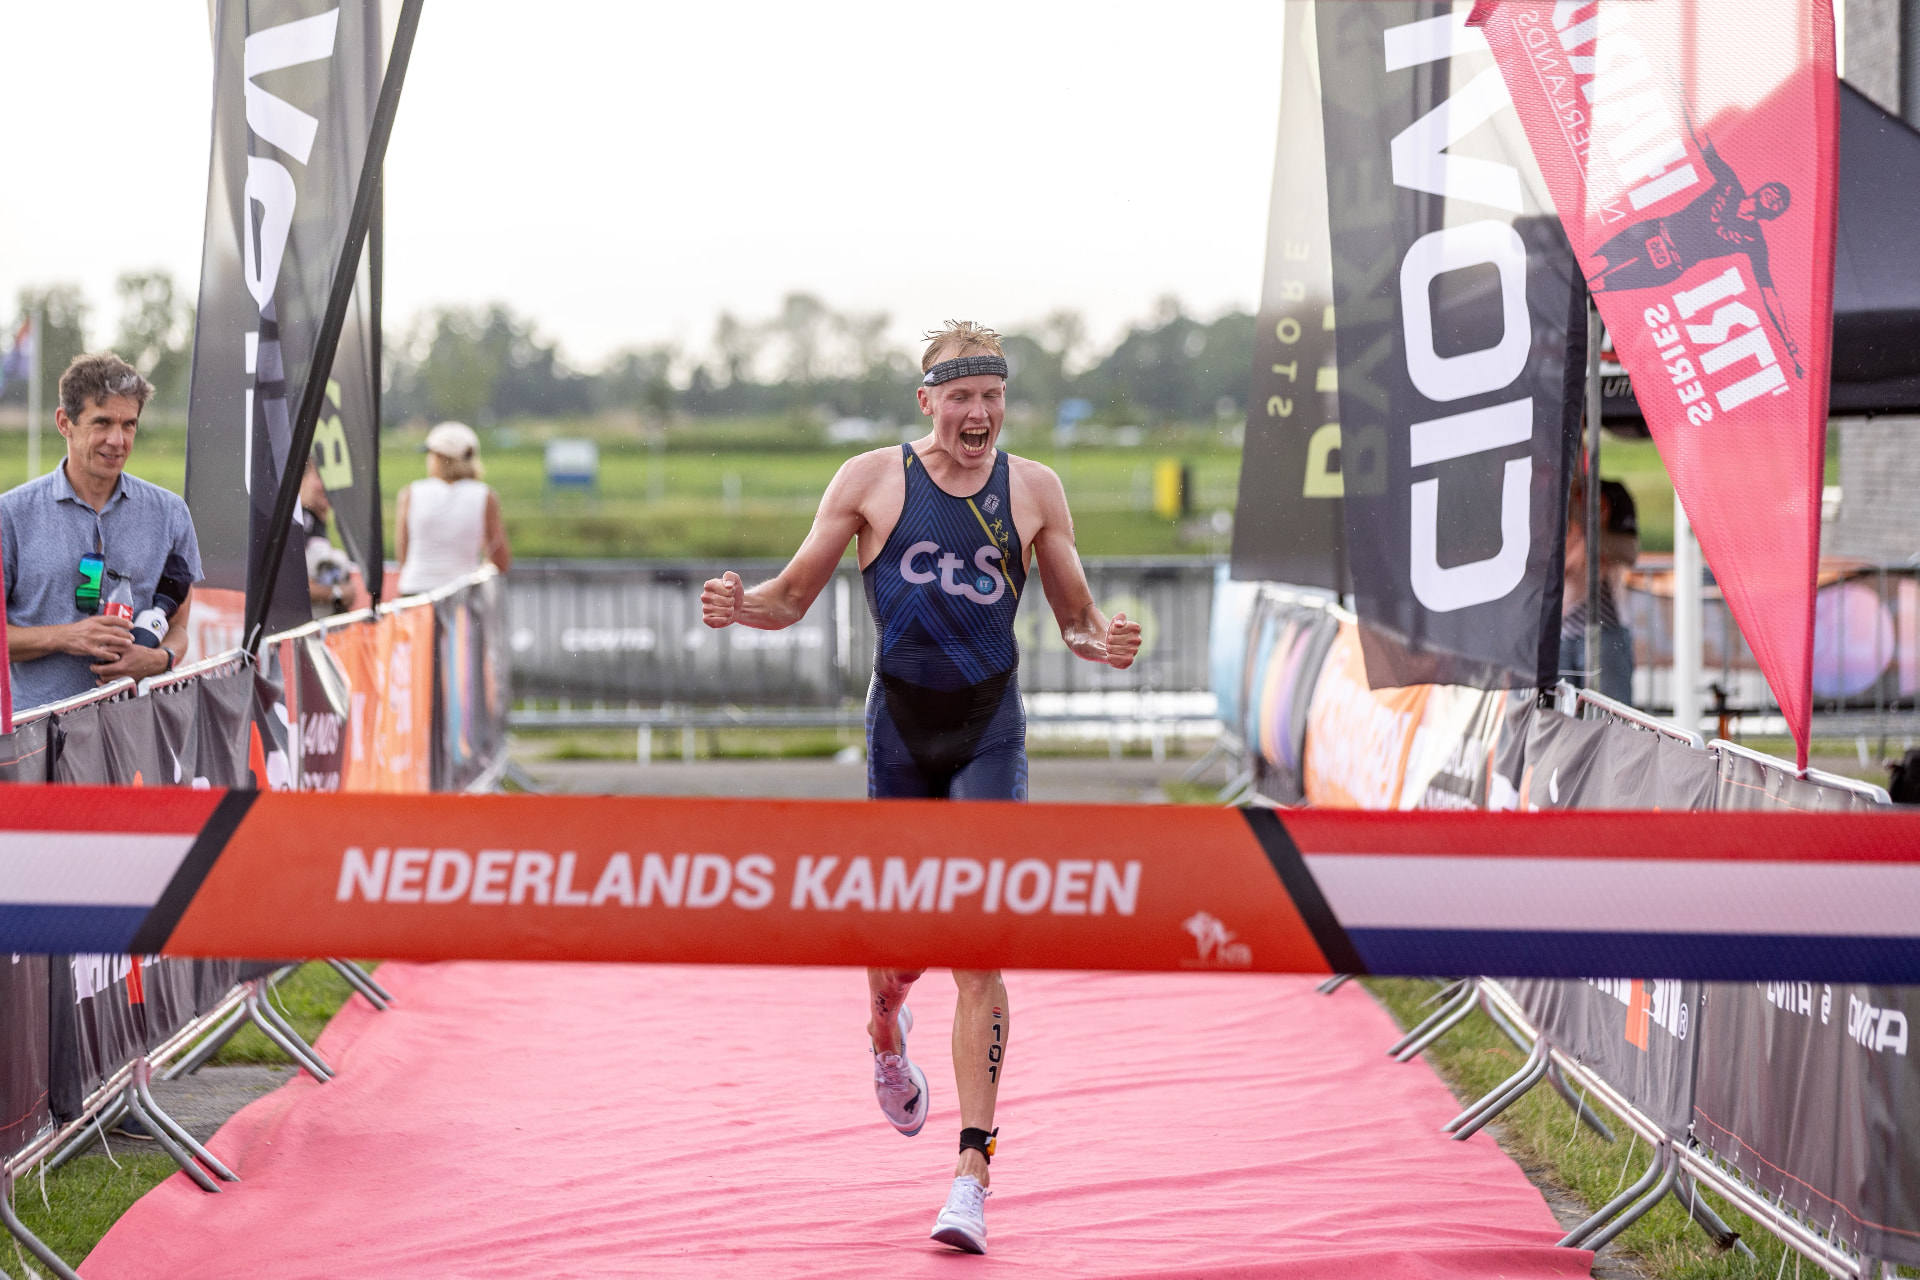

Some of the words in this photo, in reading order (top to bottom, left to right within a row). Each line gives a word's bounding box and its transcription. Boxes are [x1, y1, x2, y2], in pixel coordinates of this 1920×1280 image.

[900, 540, 1006, 605] CtS
[335, 846, 777, 909] NEDERLANDS
[790, 854, 1142, 917] KAMPIOEN
[988, 1023, 1002, 1084] 101
